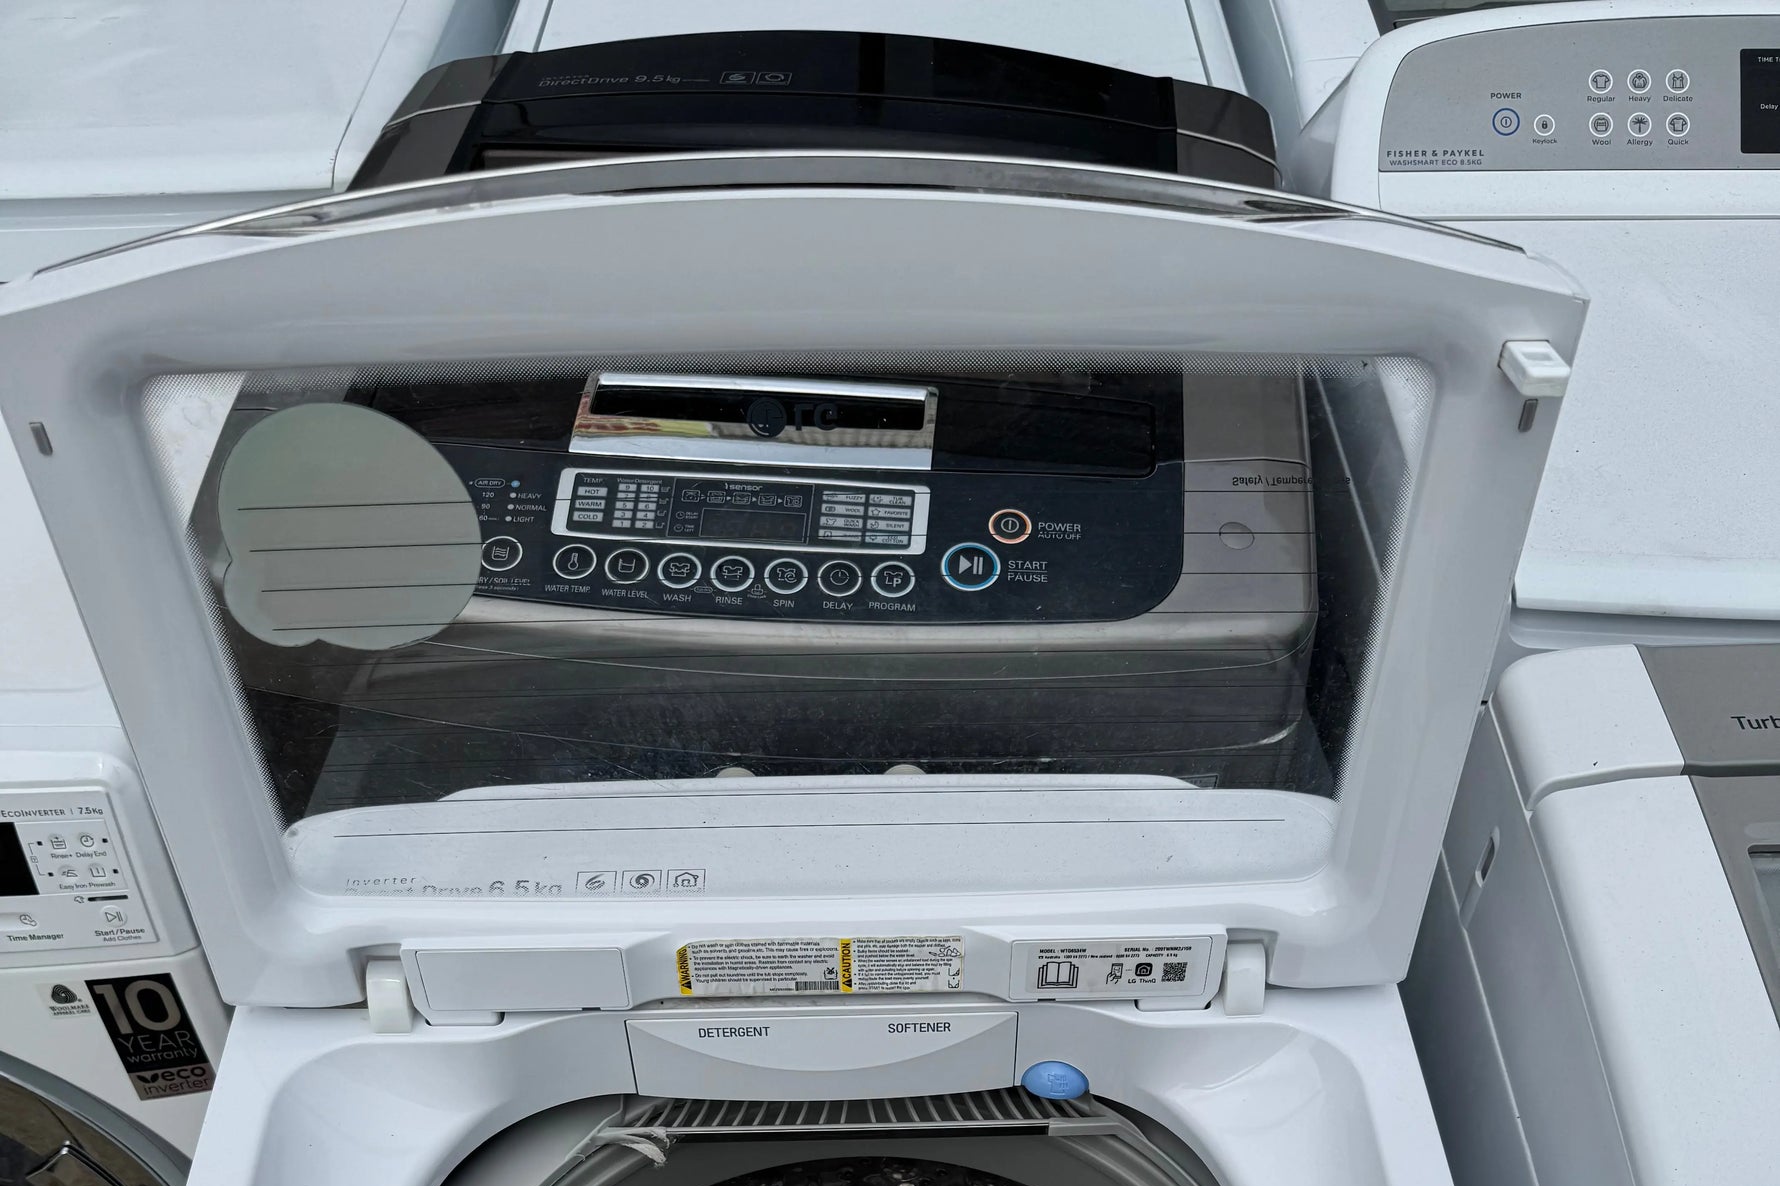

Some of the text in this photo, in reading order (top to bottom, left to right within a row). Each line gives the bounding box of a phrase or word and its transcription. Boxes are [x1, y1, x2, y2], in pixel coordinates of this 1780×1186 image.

[1490, 92, 1522, 100] POWER
[1587, 95, 1616, 103] Regular
[1628, 95, 1652, 103] Heavy
[1760, 103, 1779, 111] Delay
[1626, 138, 1654, 147] Allergy
[1667, 138, 1690, 146] Quick
[1386, 149, 1485, 158] FISHER & PAYKEL
[517, 492, 542, 500] HEAVY
[515, 504, 548, 512] NORMAL
[578, 500, 603, 508] WARM
[513, 515, 535, 523] LIGHT
[577, 513, 599, 521] COLD
[1038, 521, 1082, 533] POWER
[1008, 560, 1048, 570] START
[1007, 572, 1048, 583] PAUSE
[544, 584, 570, 593] WATER
[601, 588, 650, 599] WATER LEVEL
[662, 593, 692, 603] WASH
[715, 596, 743, 605] RINSE
[772, 599, 795, 608] SPIN
[822, 601, 854, 611] DELAY
[868, 601, 916, 612] PROGRAM
[94, 927, 146, 937] Start/Pause
[6, 933, 65, 942] Time Manager
[679, 946, 691, 983] WARNING
[841, 942, 852, 979] CAUTION
[92, 979, 181, 1035] 10
[698, 1026, 771, 1039] DETERGENT
[887, 1021, 952, 1034] SOFTENER
[117, 1030, 195, 1053] YEAR
[126, 1047, 198, 1063] warranty
[160, 1065, 207, 1082] eco
[143, 1076, 210, 1096] inverter
